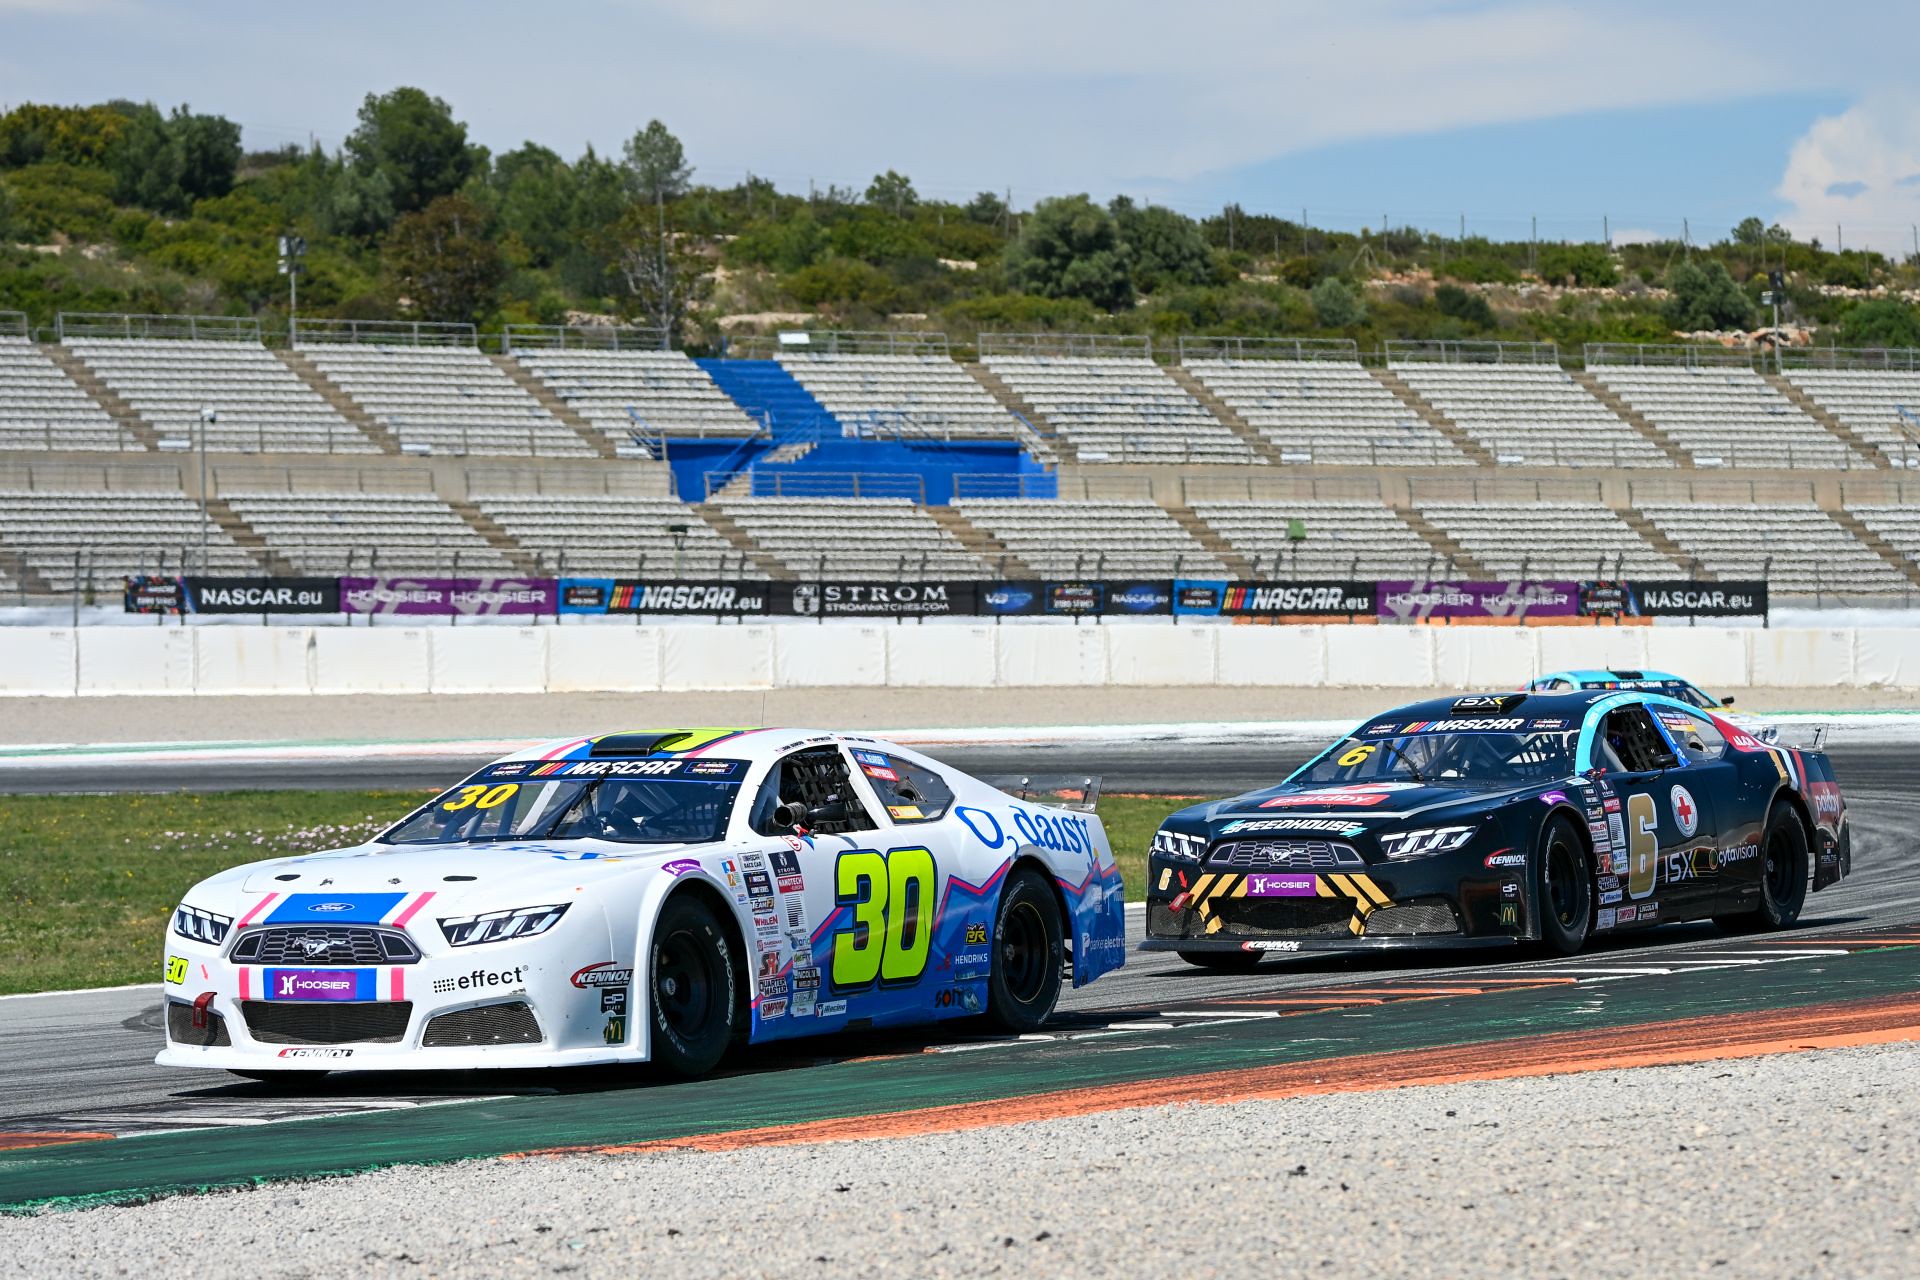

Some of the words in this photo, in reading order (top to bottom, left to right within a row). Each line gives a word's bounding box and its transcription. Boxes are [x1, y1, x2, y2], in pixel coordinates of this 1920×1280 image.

[201, 588, 322, 606] NASCAR.eu
[347, 589, 442, 604] HOOSIER
[450, 589, 546, 605] HOOSIER
[639, 586, 762, 610] NASCAR.eu
[824, 585, 949, 602] STROM
[1252, 587, 1369, 610] NASCAR.eu
[1384, 592, 1474, 606] HOOSIER
[1643, 590, 1752, 609] NASCAR.eu
[1427, 718, 1524, 732] NASCAR
[1337, 745, 1376, 767] 6
[561, 761, 683, 776] NASCAR
[442, 783, 519, 811] 30
[1225, 819, 1364, 835] SPEEDHOUSE
[1008, 805, 1094, 873] daisy
[1628, 793, 1658, 900] 6
[1488, 855, 1526, 865] KENNOL
[1718, 844, 1758, 867] cytavision
[1158, 867, 1173, 891] 6
[1266, 881, 1311, 890] HOOSIER
[831, 846, 938, 992] 30
[1246, 941, 1301, 949] KENNOL
[955, 952, 988, 964] HENDRIKS
[165, 955, 190, 985] 30
[575, 970, 630, 984] KENNOL
[295, 980, 351, 990] HOOSIER
[283, 1048, 352, 1059] KENNOL
